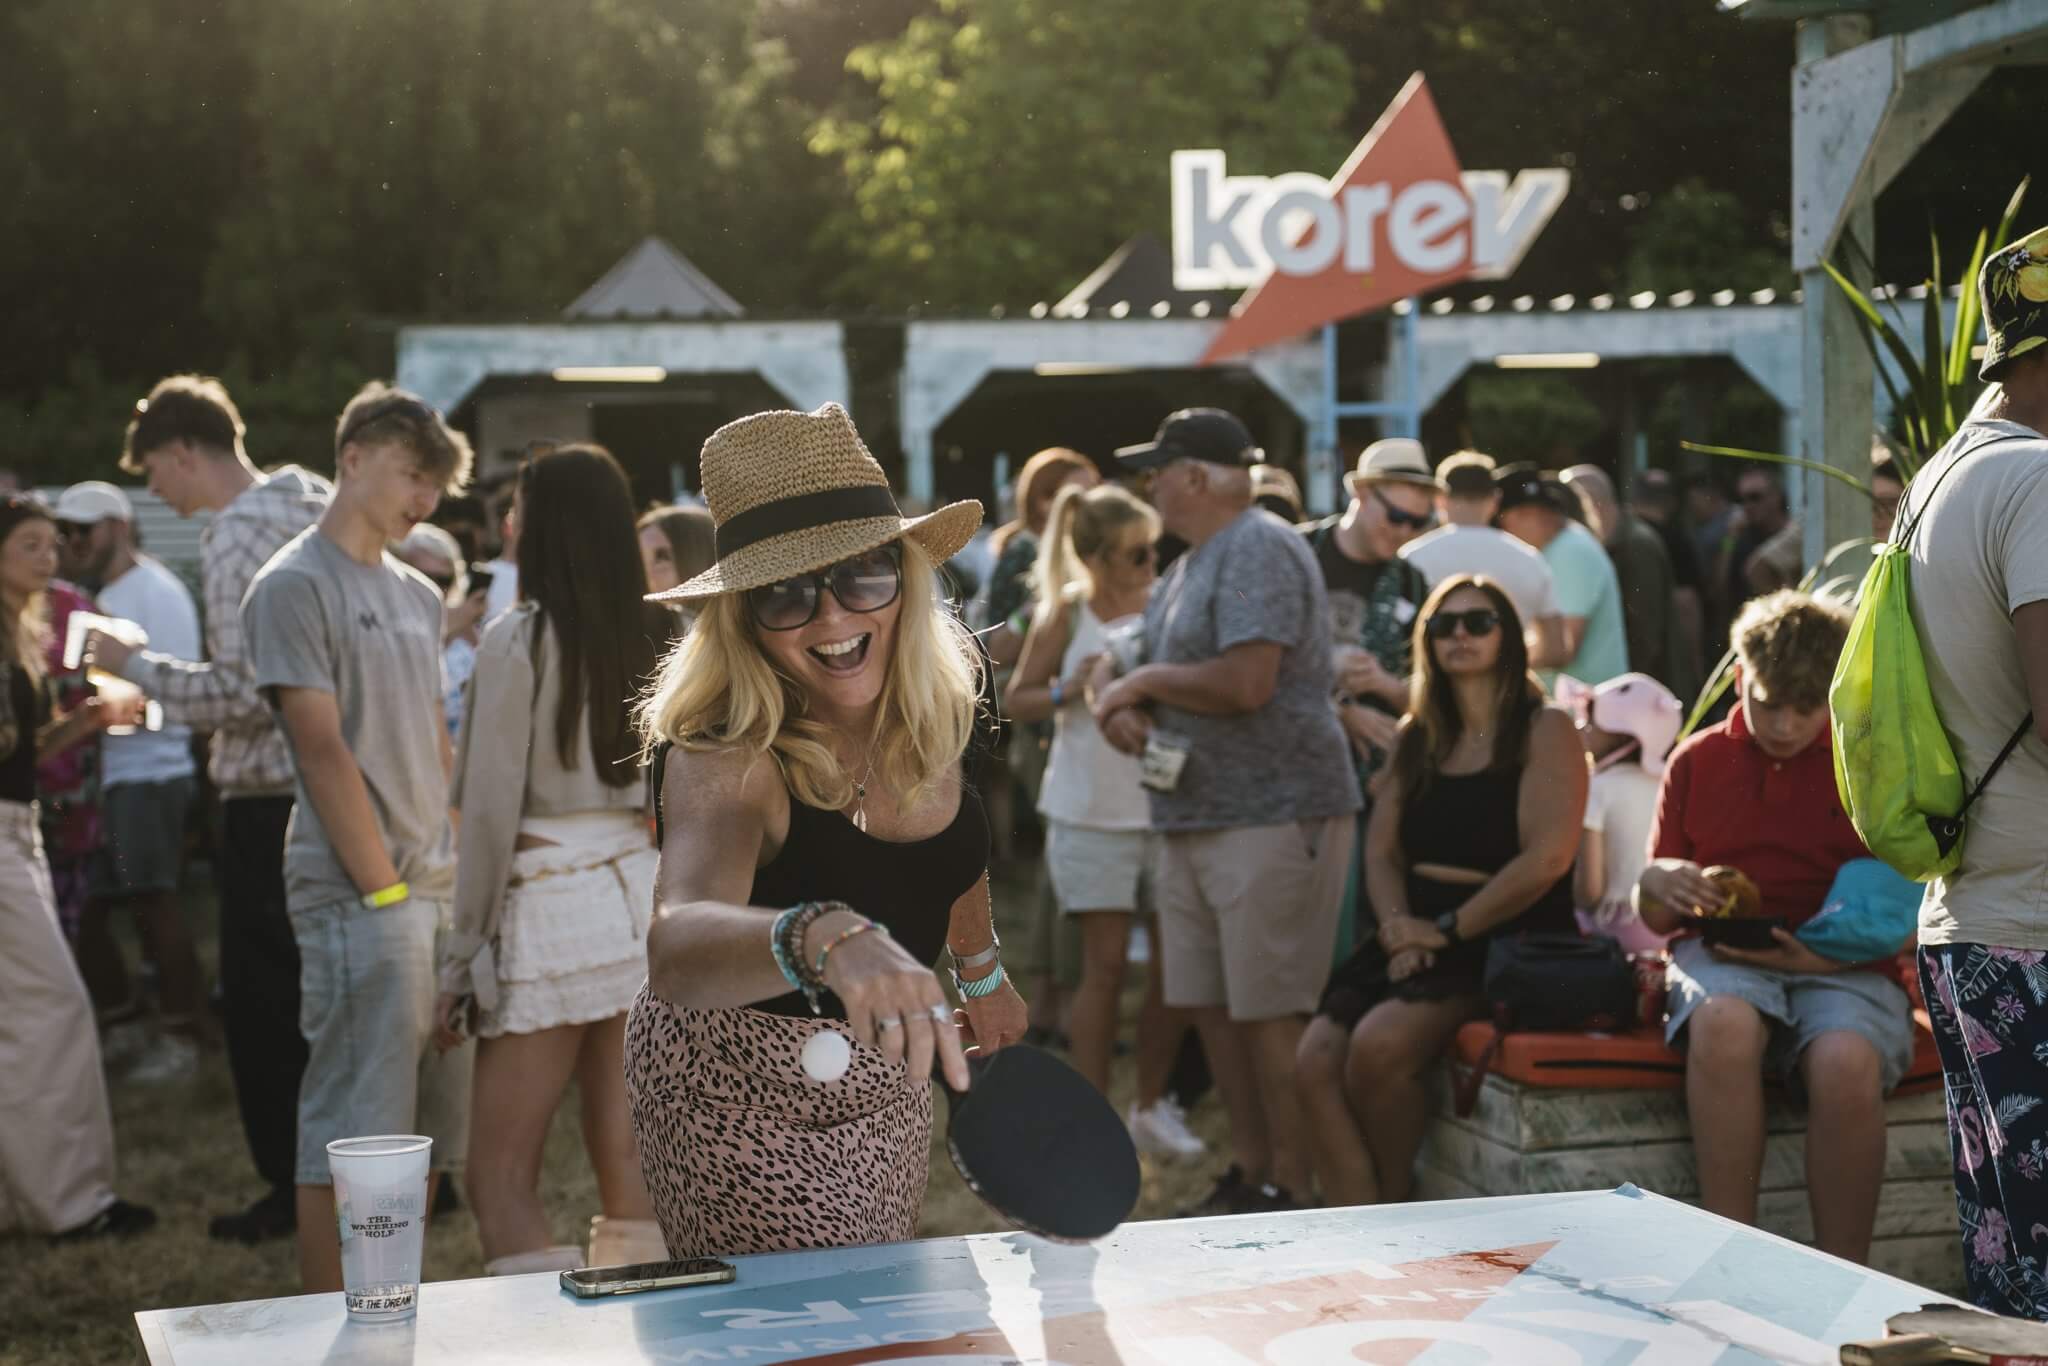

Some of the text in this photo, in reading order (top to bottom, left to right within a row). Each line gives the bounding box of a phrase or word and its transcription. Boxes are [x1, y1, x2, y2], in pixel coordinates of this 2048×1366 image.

[1180, 158, 1562, 280] korev
[351, 1221, 408, 1230] WATERING
[365, 1230, 395, 1238] HOLE
[366, 1299, 382, 1309] THE
[383, 1295, 411, 1309] DREAM
